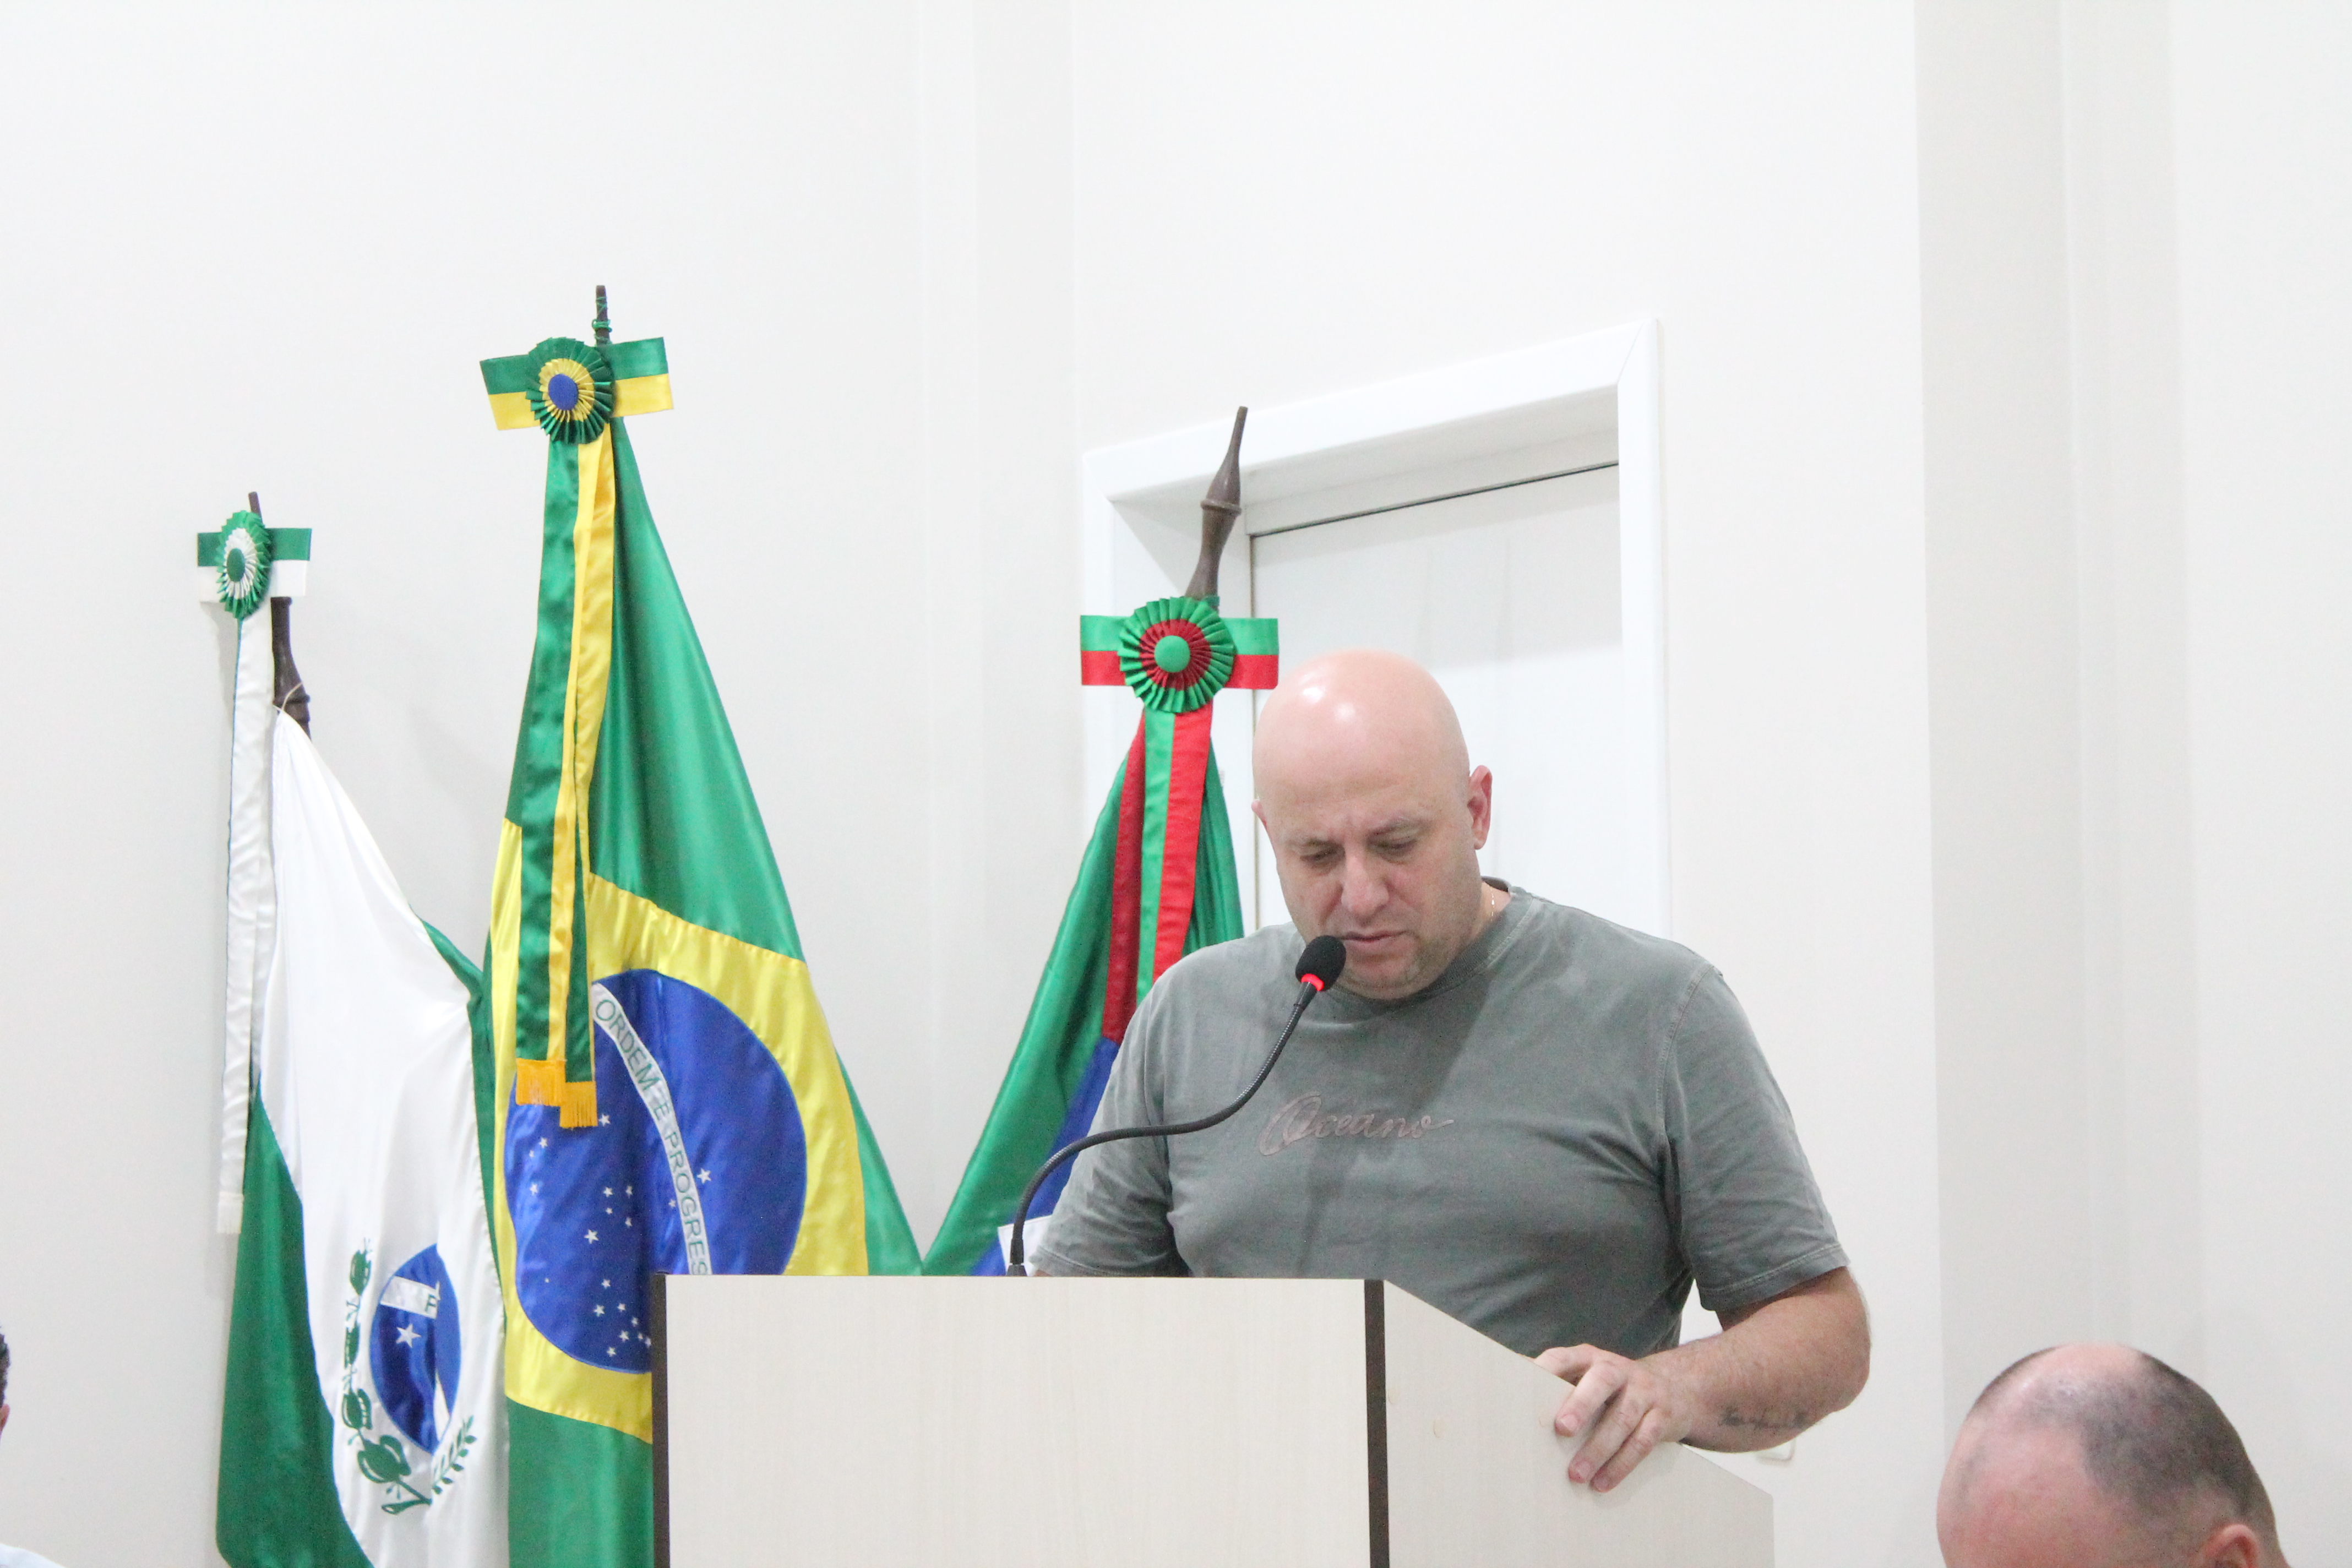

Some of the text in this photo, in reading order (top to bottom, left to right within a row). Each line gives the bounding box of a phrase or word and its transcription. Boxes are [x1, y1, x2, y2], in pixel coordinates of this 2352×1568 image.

[596, 999, 661, 1091] ORDEM
[654, 1102, 670, 1120] E
[1259, 1091, 1454, 1156] Oceano
